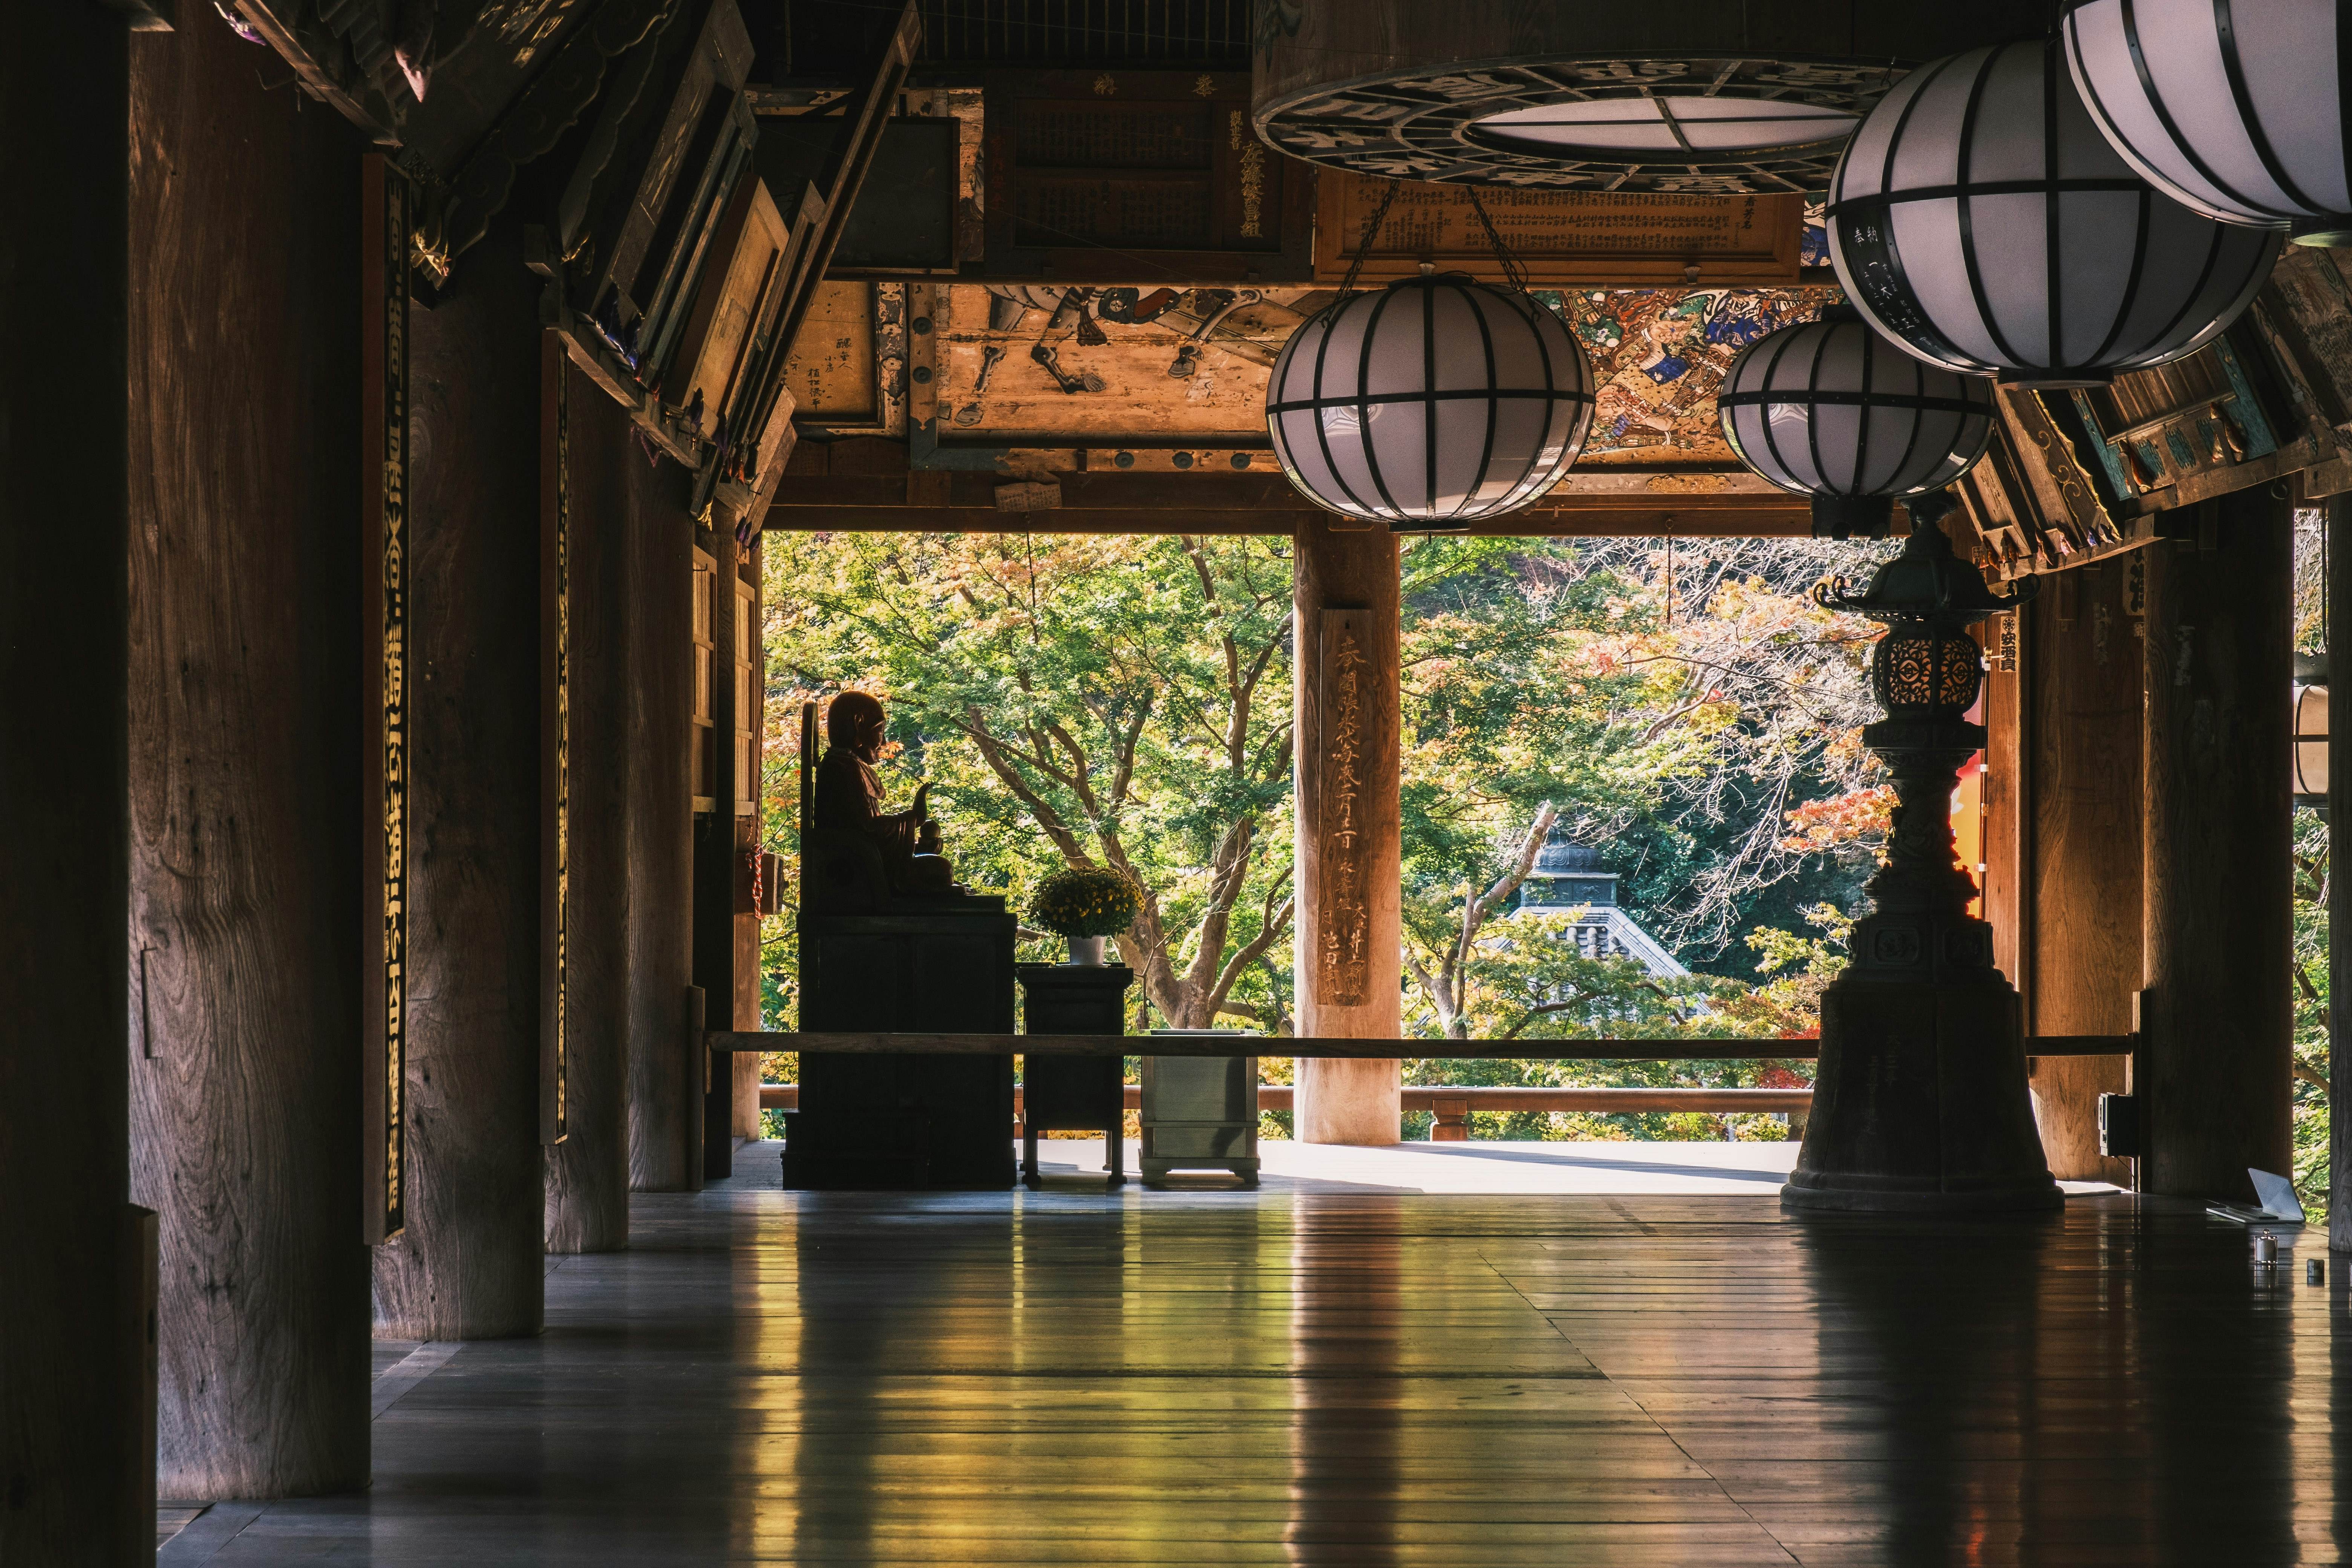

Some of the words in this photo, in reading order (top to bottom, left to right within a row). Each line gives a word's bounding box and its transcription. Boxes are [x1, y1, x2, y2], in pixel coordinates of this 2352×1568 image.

[1650, 175, 1759, 193] 酉
[1532, 214, 1539, 225] 山田
[1854, 225, 1879, 248] 奉納
